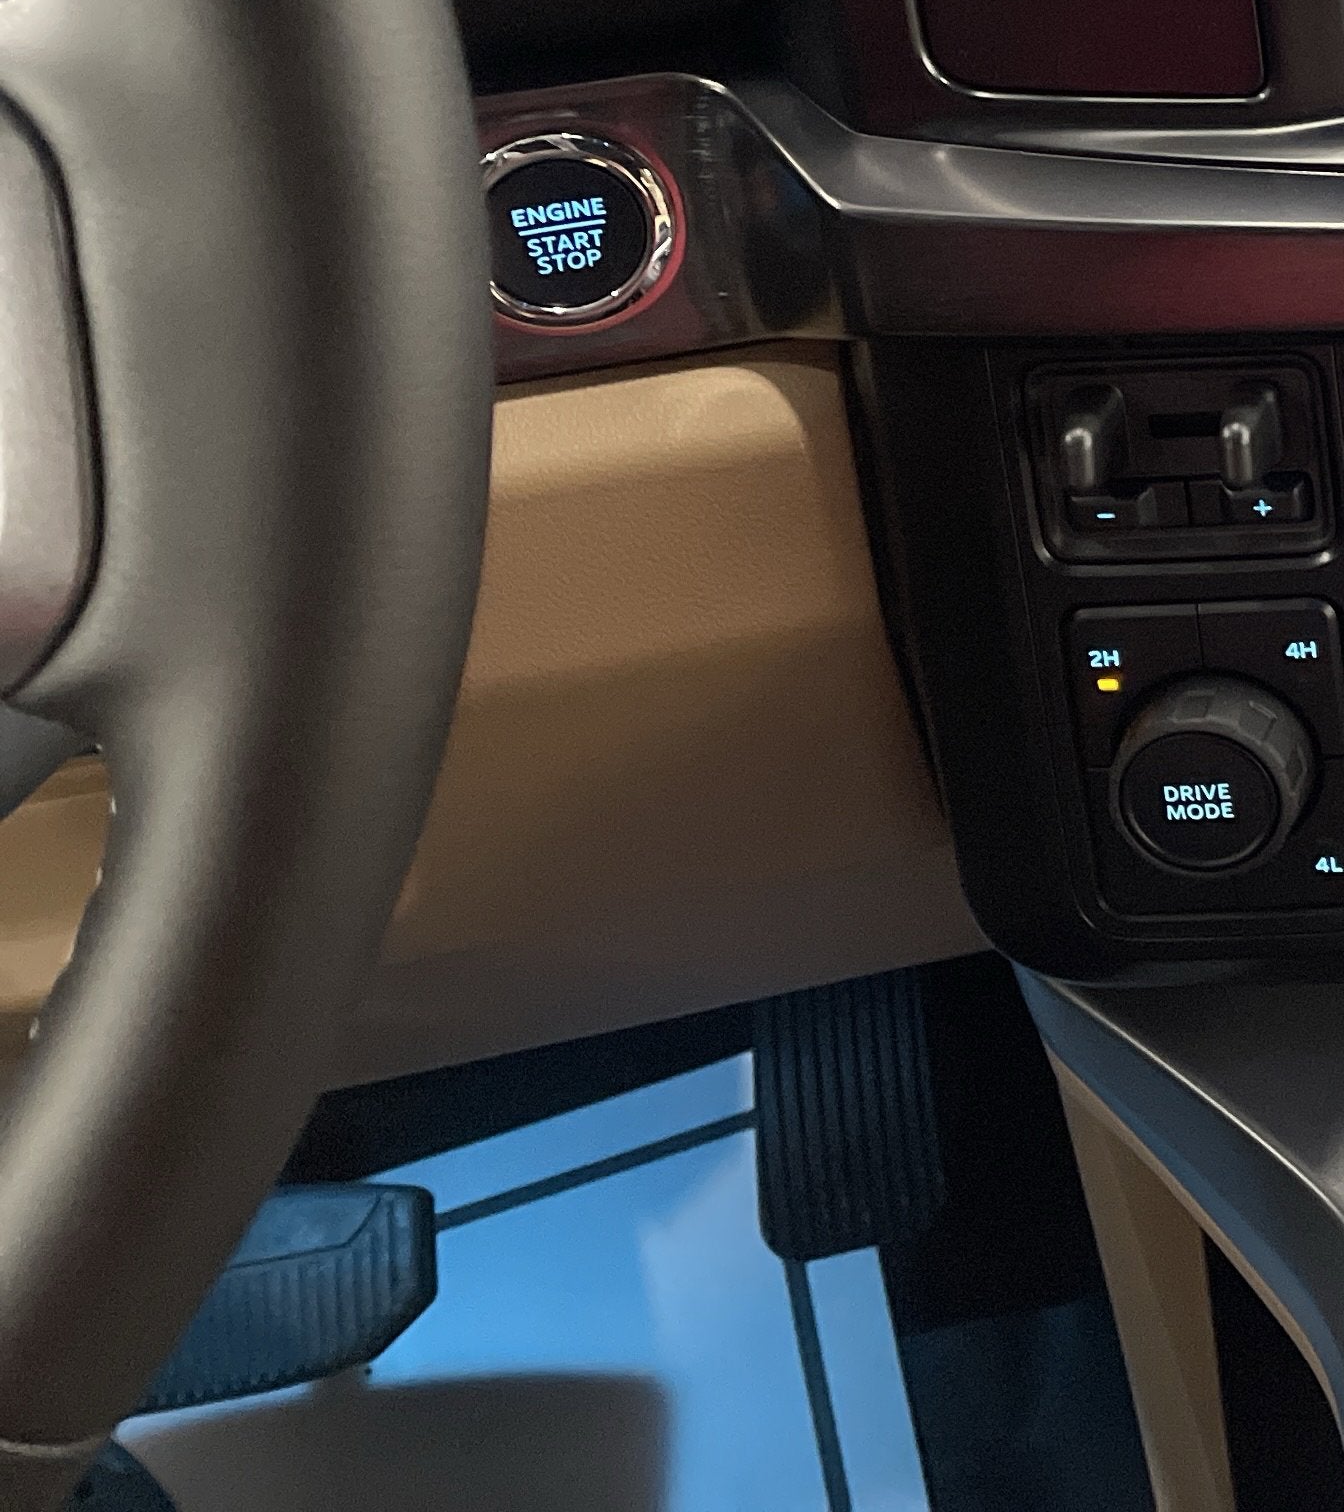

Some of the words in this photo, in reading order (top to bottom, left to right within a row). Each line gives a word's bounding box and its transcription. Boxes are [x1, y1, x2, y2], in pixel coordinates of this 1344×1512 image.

[510, 197, 607, 228] ENGINE
[526, 229, 604, 258] START
[536, 249, 602, 276] STOP
[1088, 649, 1121, 669] 2H
[1285, 640, 1318, 661] 4H
[1163, 782, 1232, 803] DRIVE
[1166, 801, 1235, 821] MODE
[1315, 857, 1344, 874] 4L
